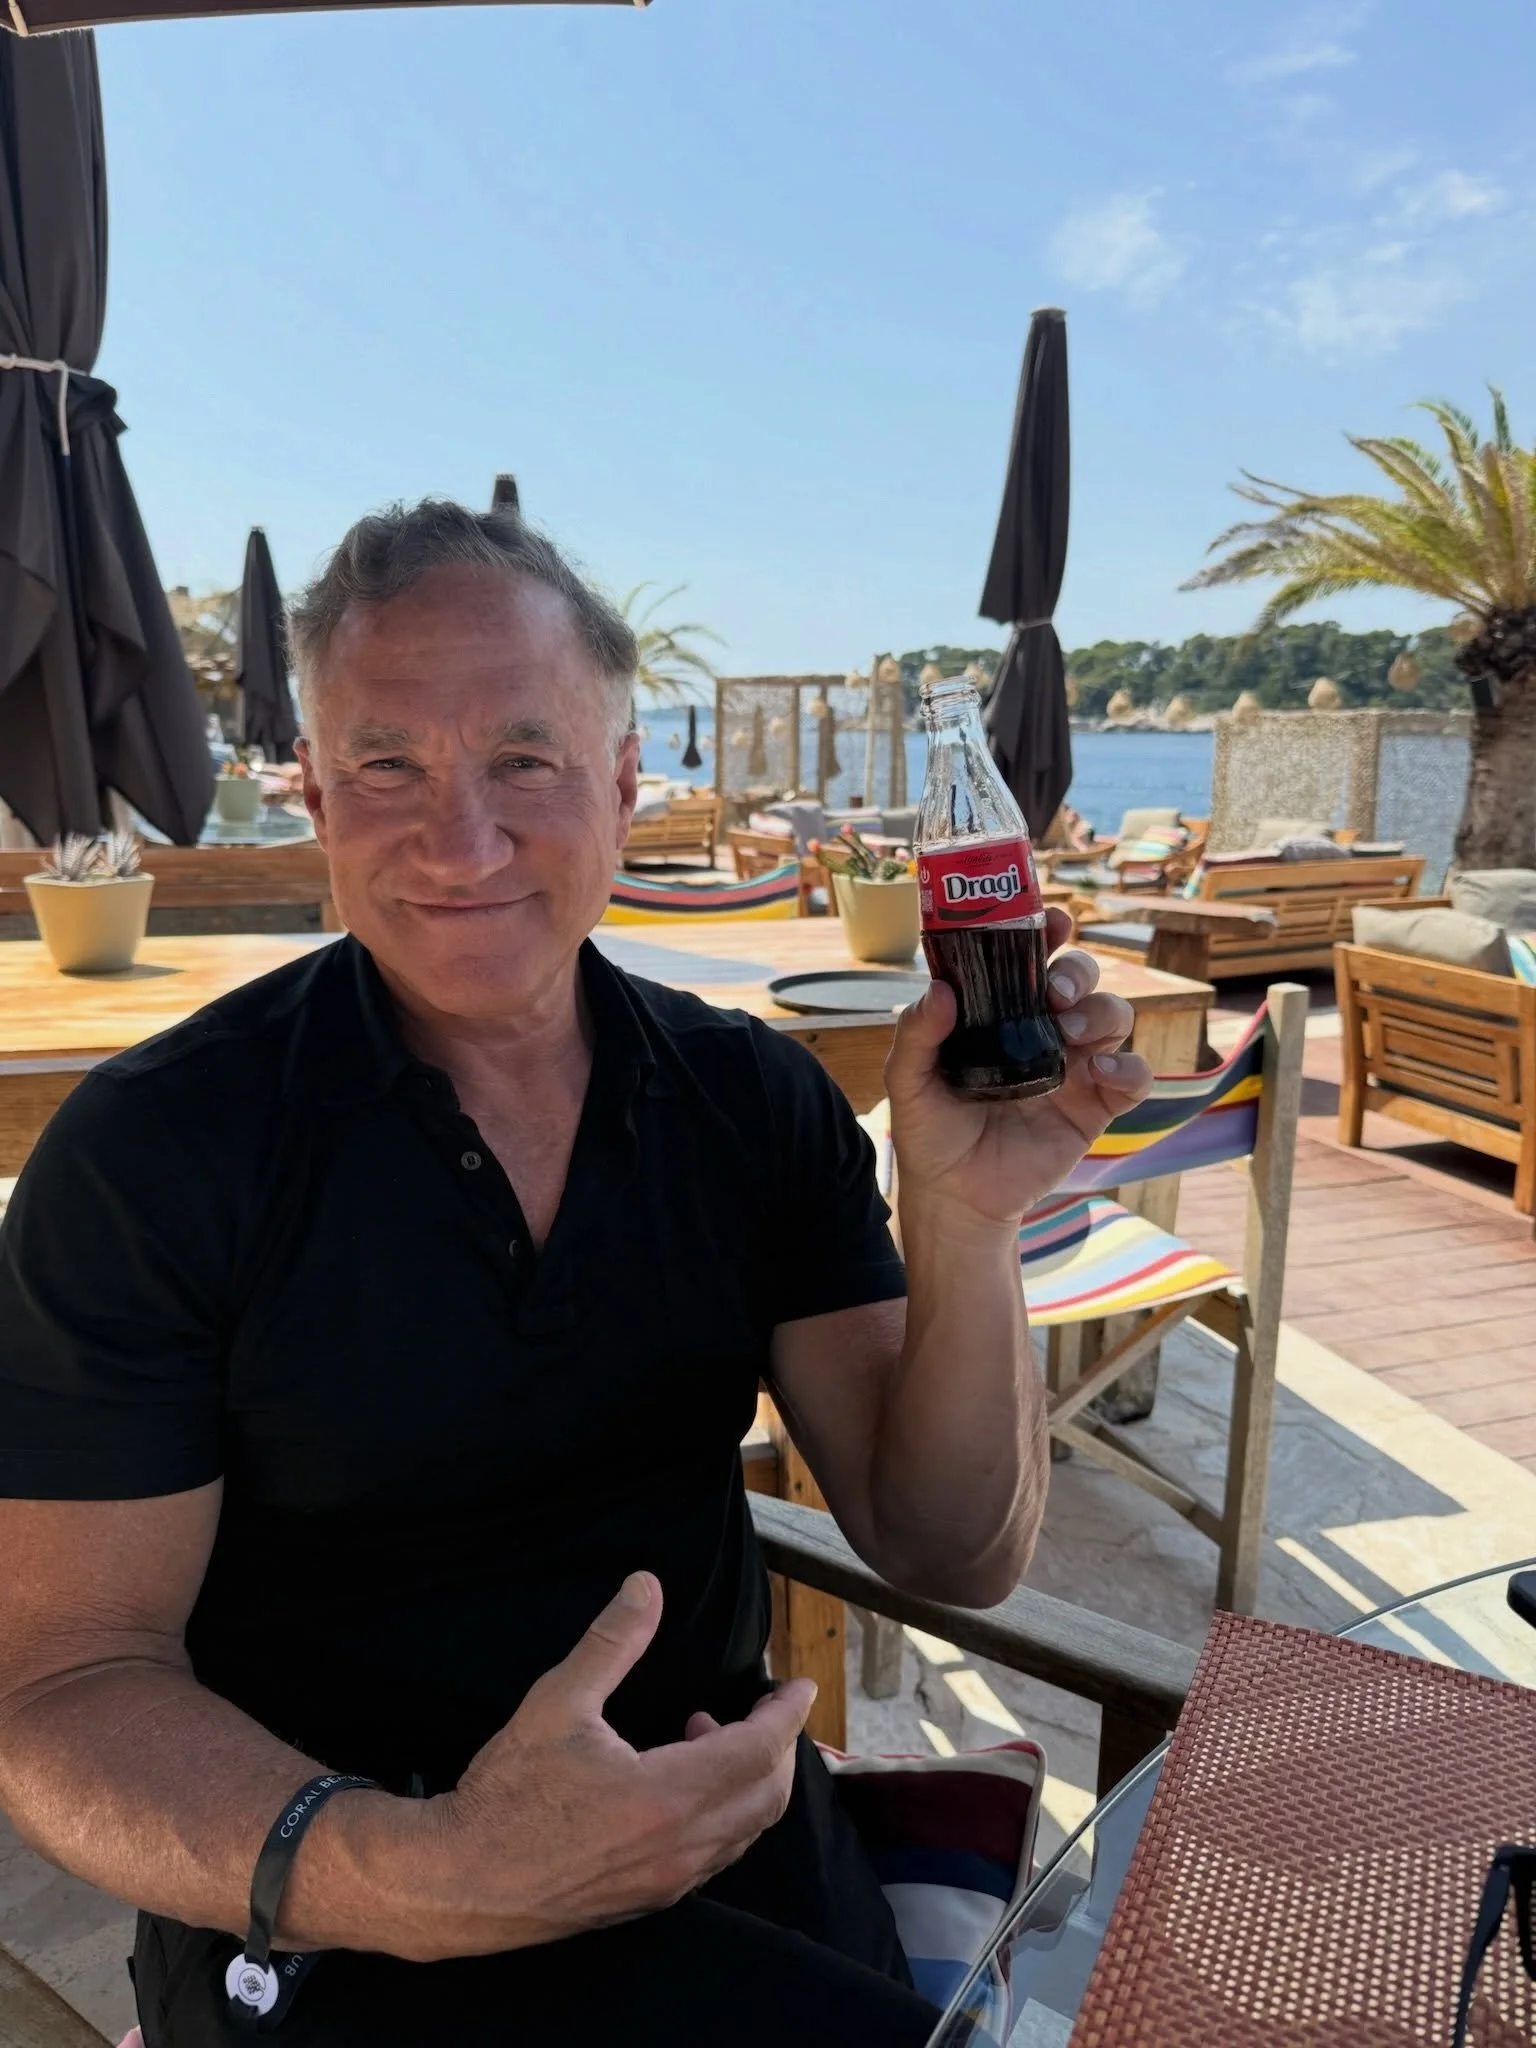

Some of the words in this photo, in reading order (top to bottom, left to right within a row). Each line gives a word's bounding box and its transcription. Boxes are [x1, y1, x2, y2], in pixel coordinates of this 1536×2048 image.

[942, 864, 1020, 902] Dragi
[280, 1789, 321, 1838] CORAL
[284, 1954, 304, 1977] UB
